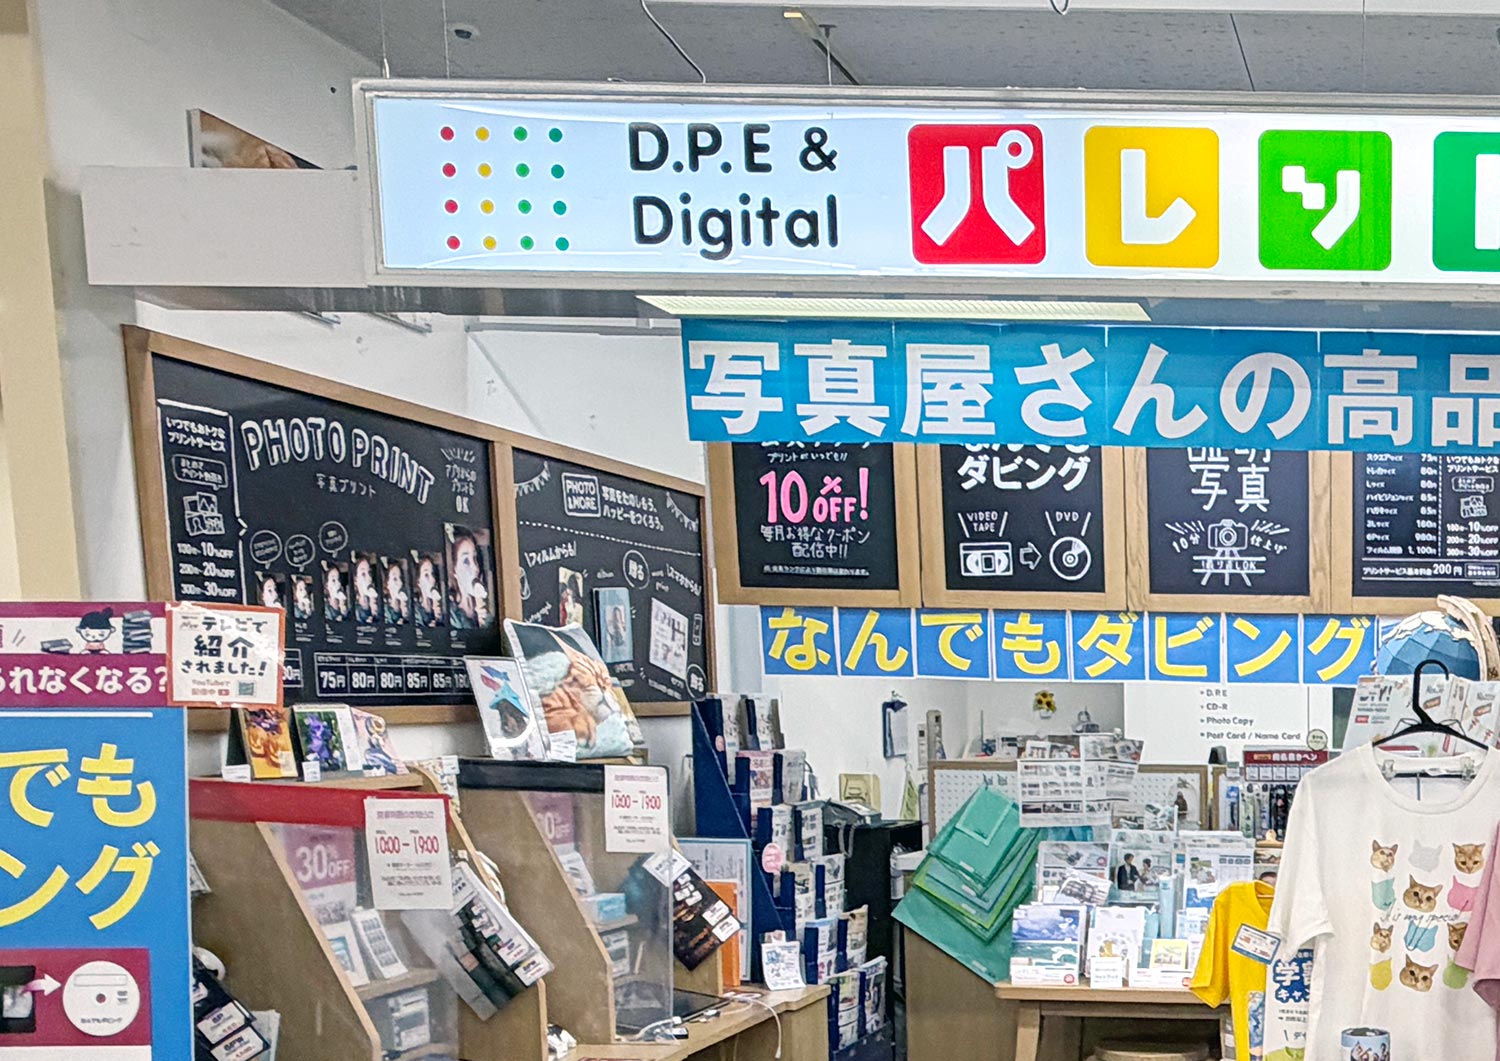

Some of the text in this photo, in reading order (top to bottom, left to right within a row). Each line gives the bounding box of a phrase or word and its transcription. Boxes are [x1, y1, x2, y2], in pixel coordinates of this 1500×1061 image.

[627, 122, 839, 174] D.P.E &
[632, 193, 839, 261] Digital
[240, 416, 435, 505] PHOTO PRINT
[315, 472, 378, 499] 写真プリント
[957, 455, 1092, 492] ダビング
[565, 479, 596, 495] PHOTO
[759, 469, 843, 524] 10%
[1189, 463, 1271, 514] 写真
[455, 494, 470, 514] OK
[966, 510, 999, 523] VIDEO
[1055, 510, 1080, 523] DVD
[759, 524, 871, 545] 毎月お得なクーポン
[972, 521, 996, 534] TAPE
[201, 615, 269, 634] テレビで
[193, 634, 255, 659] 紹介
[766, 605, 1373, 682] なんでもダビング
[181, 659, 268, 677] されました!
[1206, 716, 1255, 728] Photo Copy
[0, 743, 157, 828] でも
[327, 858, 351, 879] OFF
[0, 840, 161, 930] ング
